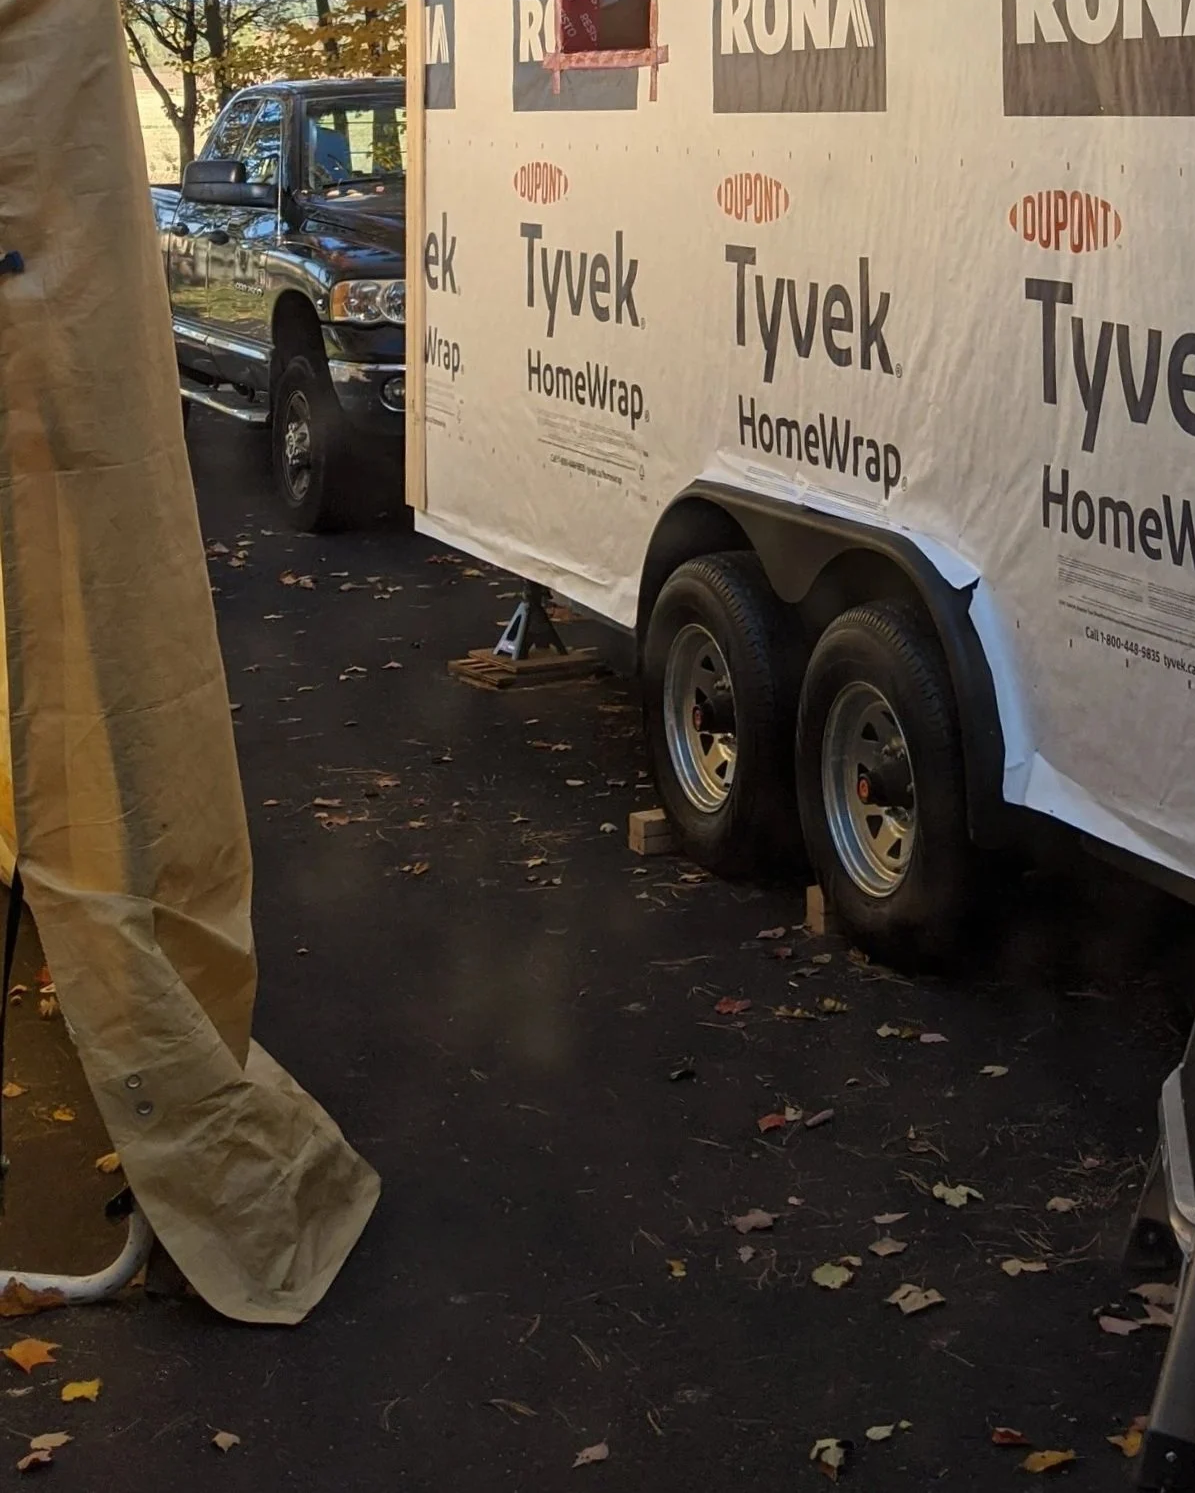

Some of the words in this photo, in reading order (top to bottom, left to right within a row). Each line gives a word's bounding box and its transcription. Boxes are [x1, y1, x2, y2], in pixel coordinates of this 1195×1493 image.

[519, 161, 564, 205] DUPONT
[723, 172, 783, 224] DUPONT
[1022, 189, 1111, 253] DUPONT
[520, 222, 640, 339] Tyvek
[725, 244, 895, 384] Tyvek
[527, 348, 644, 431] HomeWrap
[737, 393, 901, 500] HomeWrap
[1085, 624, 1099, 643] Call
[1100, 631, 1161, 664] 1-800-448-9835
